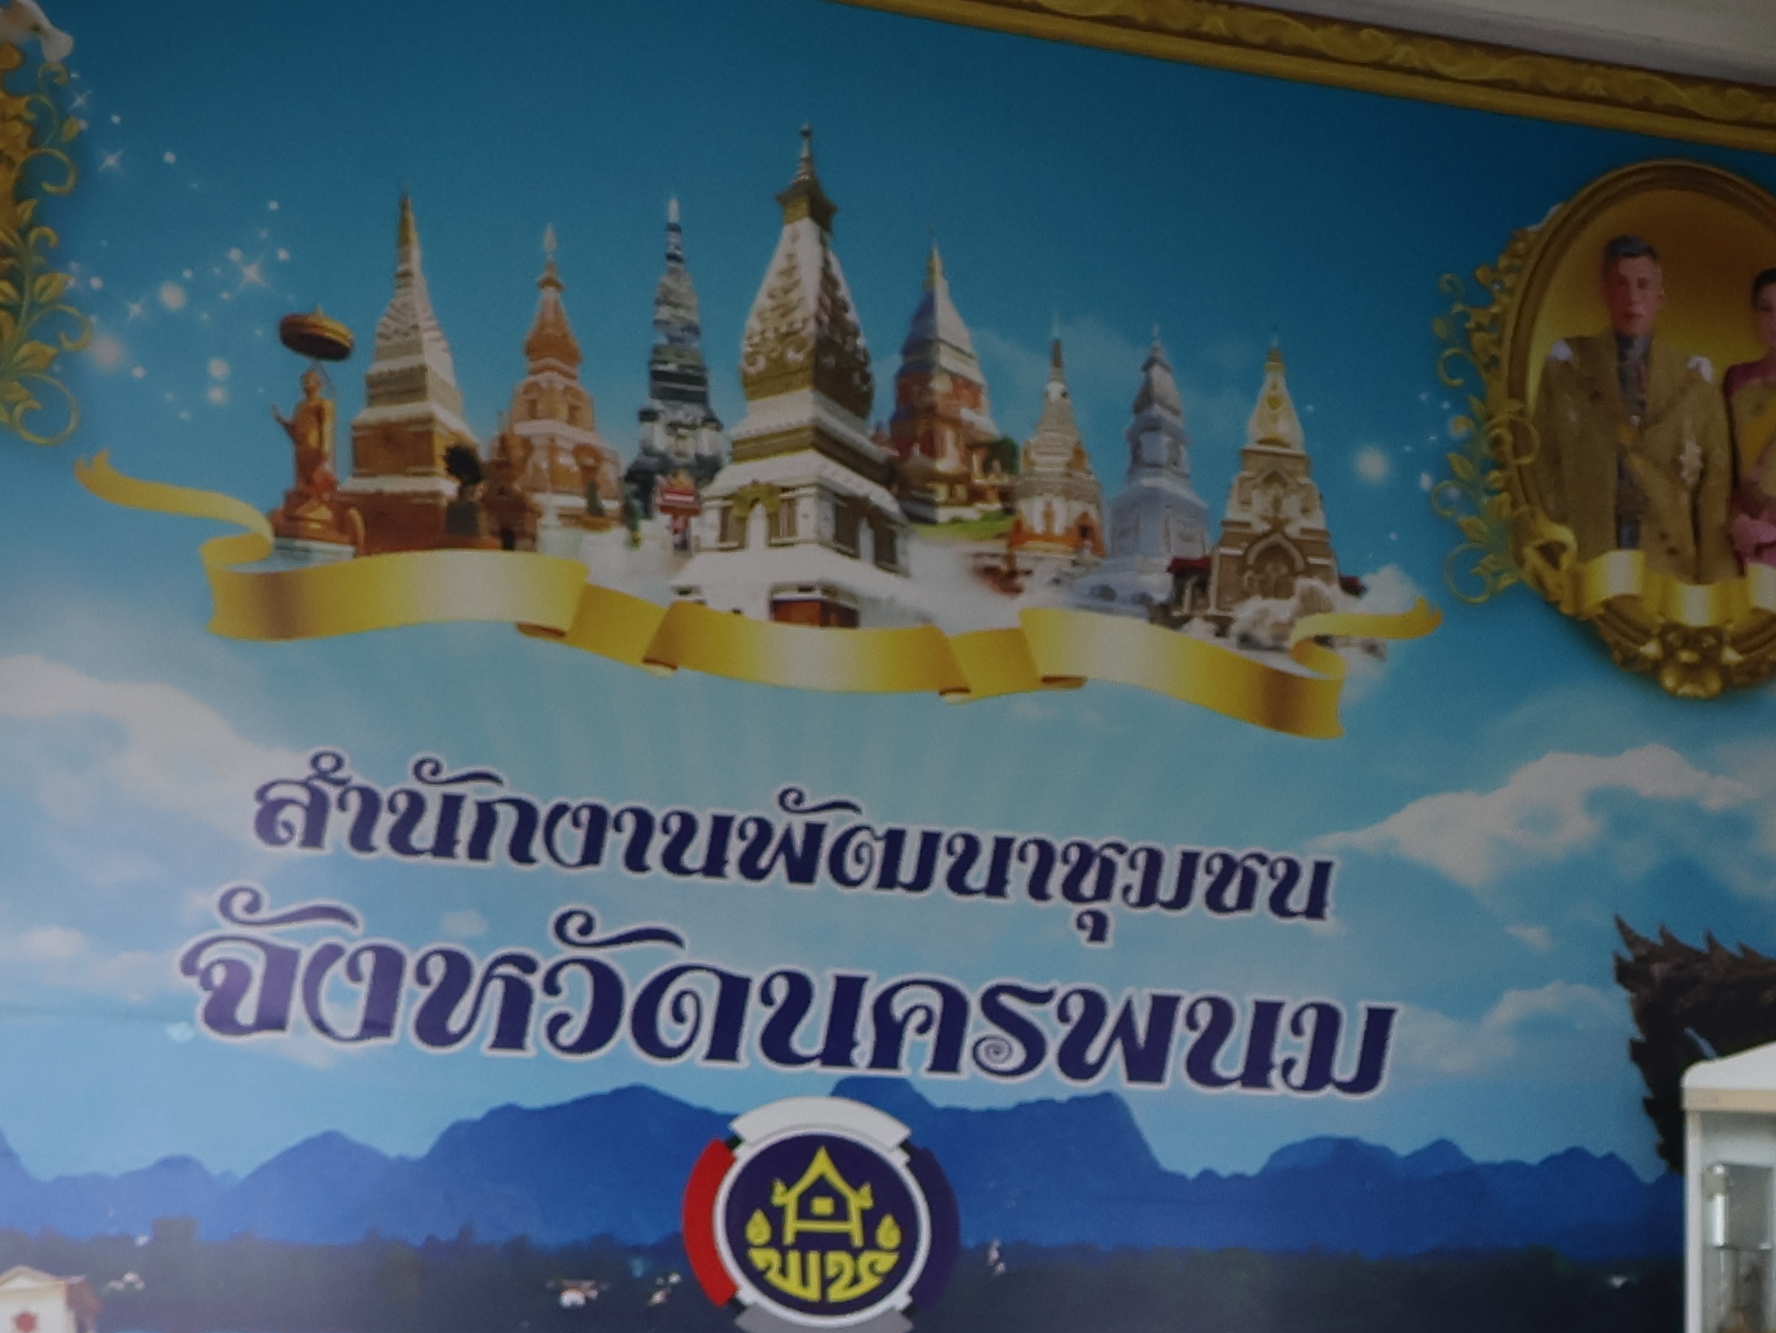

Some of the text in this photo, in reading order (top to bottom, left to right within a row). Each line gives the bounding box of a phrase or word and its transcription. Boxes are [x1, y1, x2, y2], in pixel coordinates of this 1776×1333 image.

[250, 750, 1336, 943] สำนักงานพัฒนาชุมชน
[181, 885, 1398, 1100] จังหวัดนครพนม
